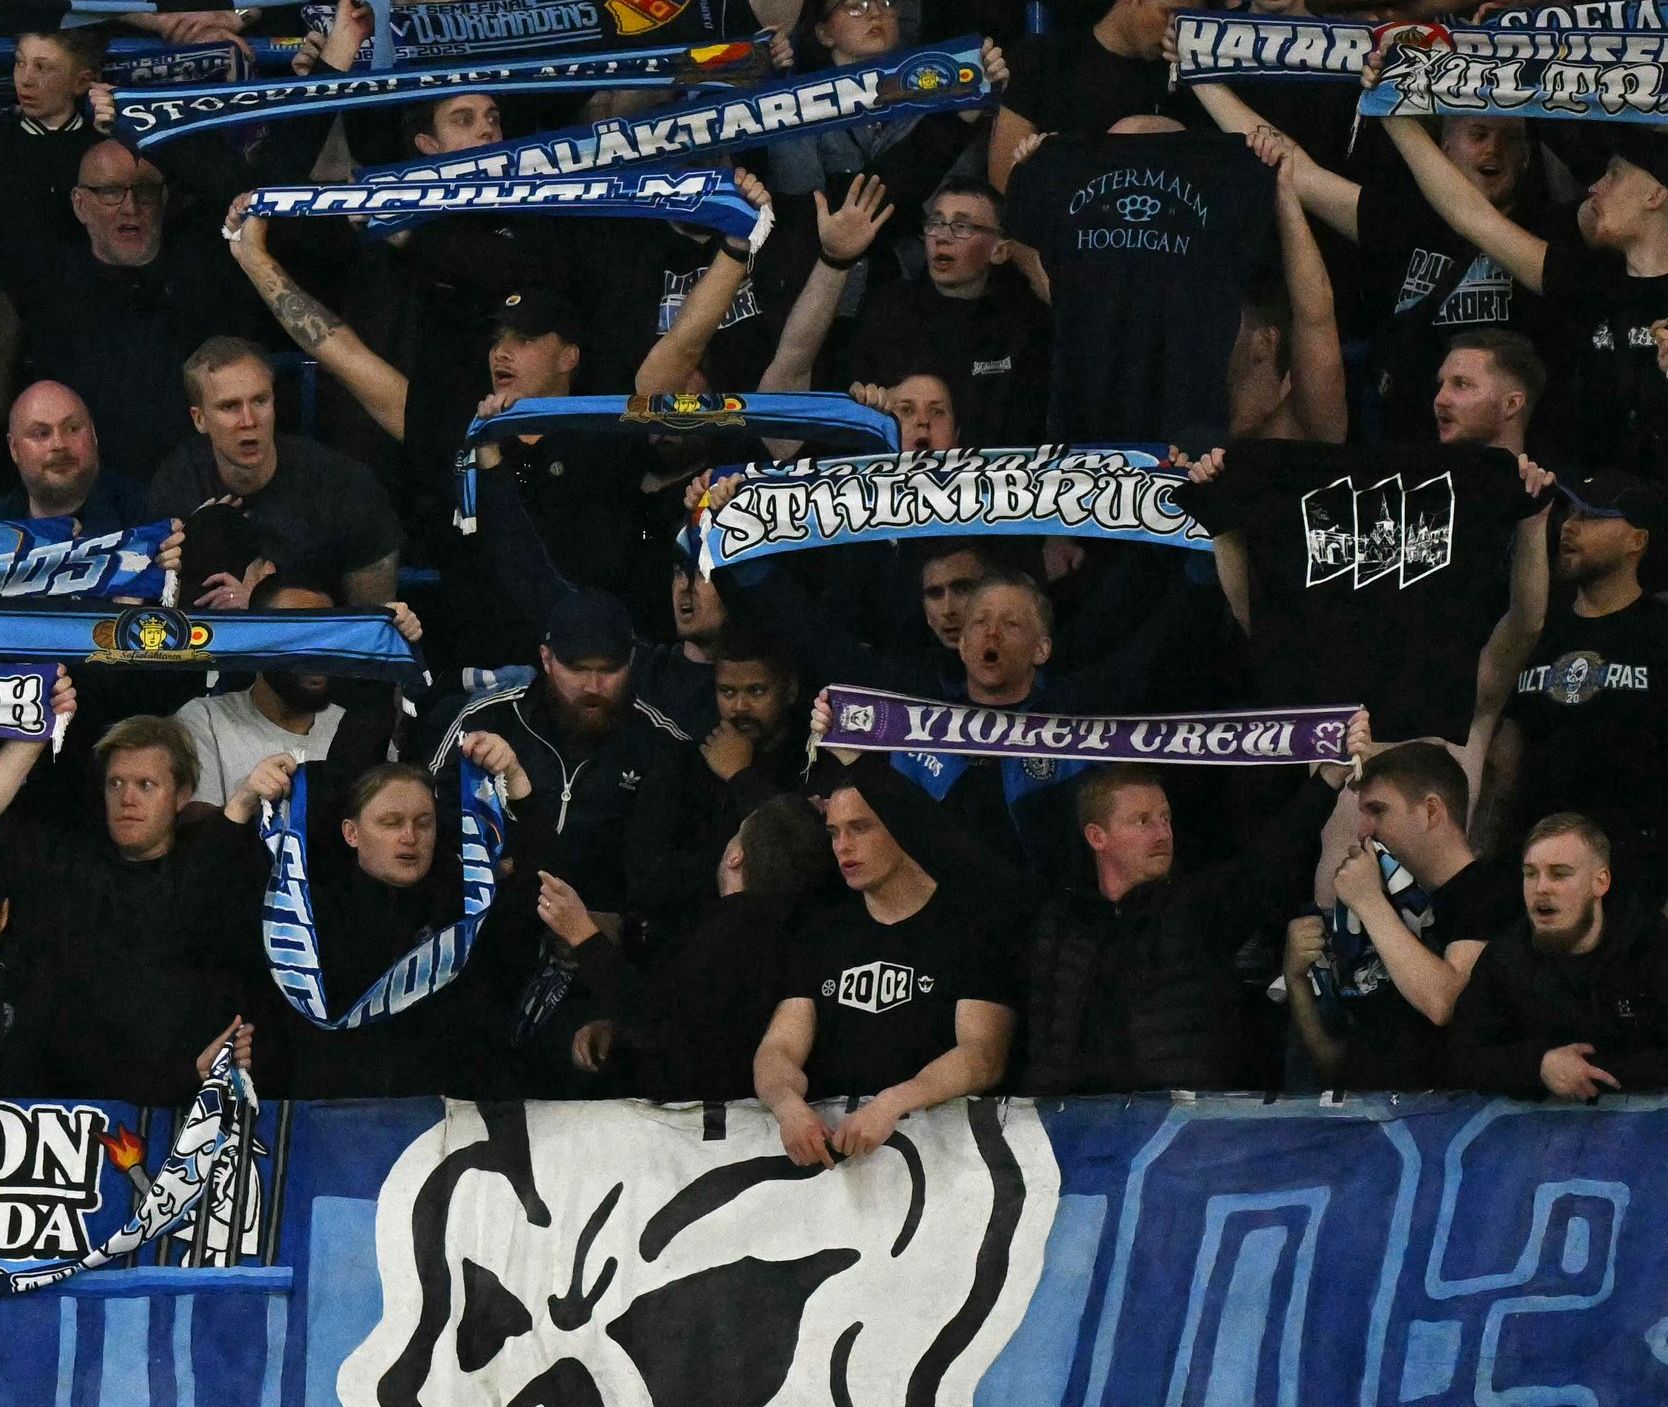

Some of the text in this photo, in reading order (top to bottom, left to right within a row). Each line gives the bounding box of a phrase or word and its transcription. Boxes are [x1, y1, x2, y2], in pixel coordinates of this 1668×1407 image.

[1178, 16, 1374, 79] HATAR
[1075, 226, 1191, 256] HOOLIGAN
[904, 704, 1120, 752] VIOLET
